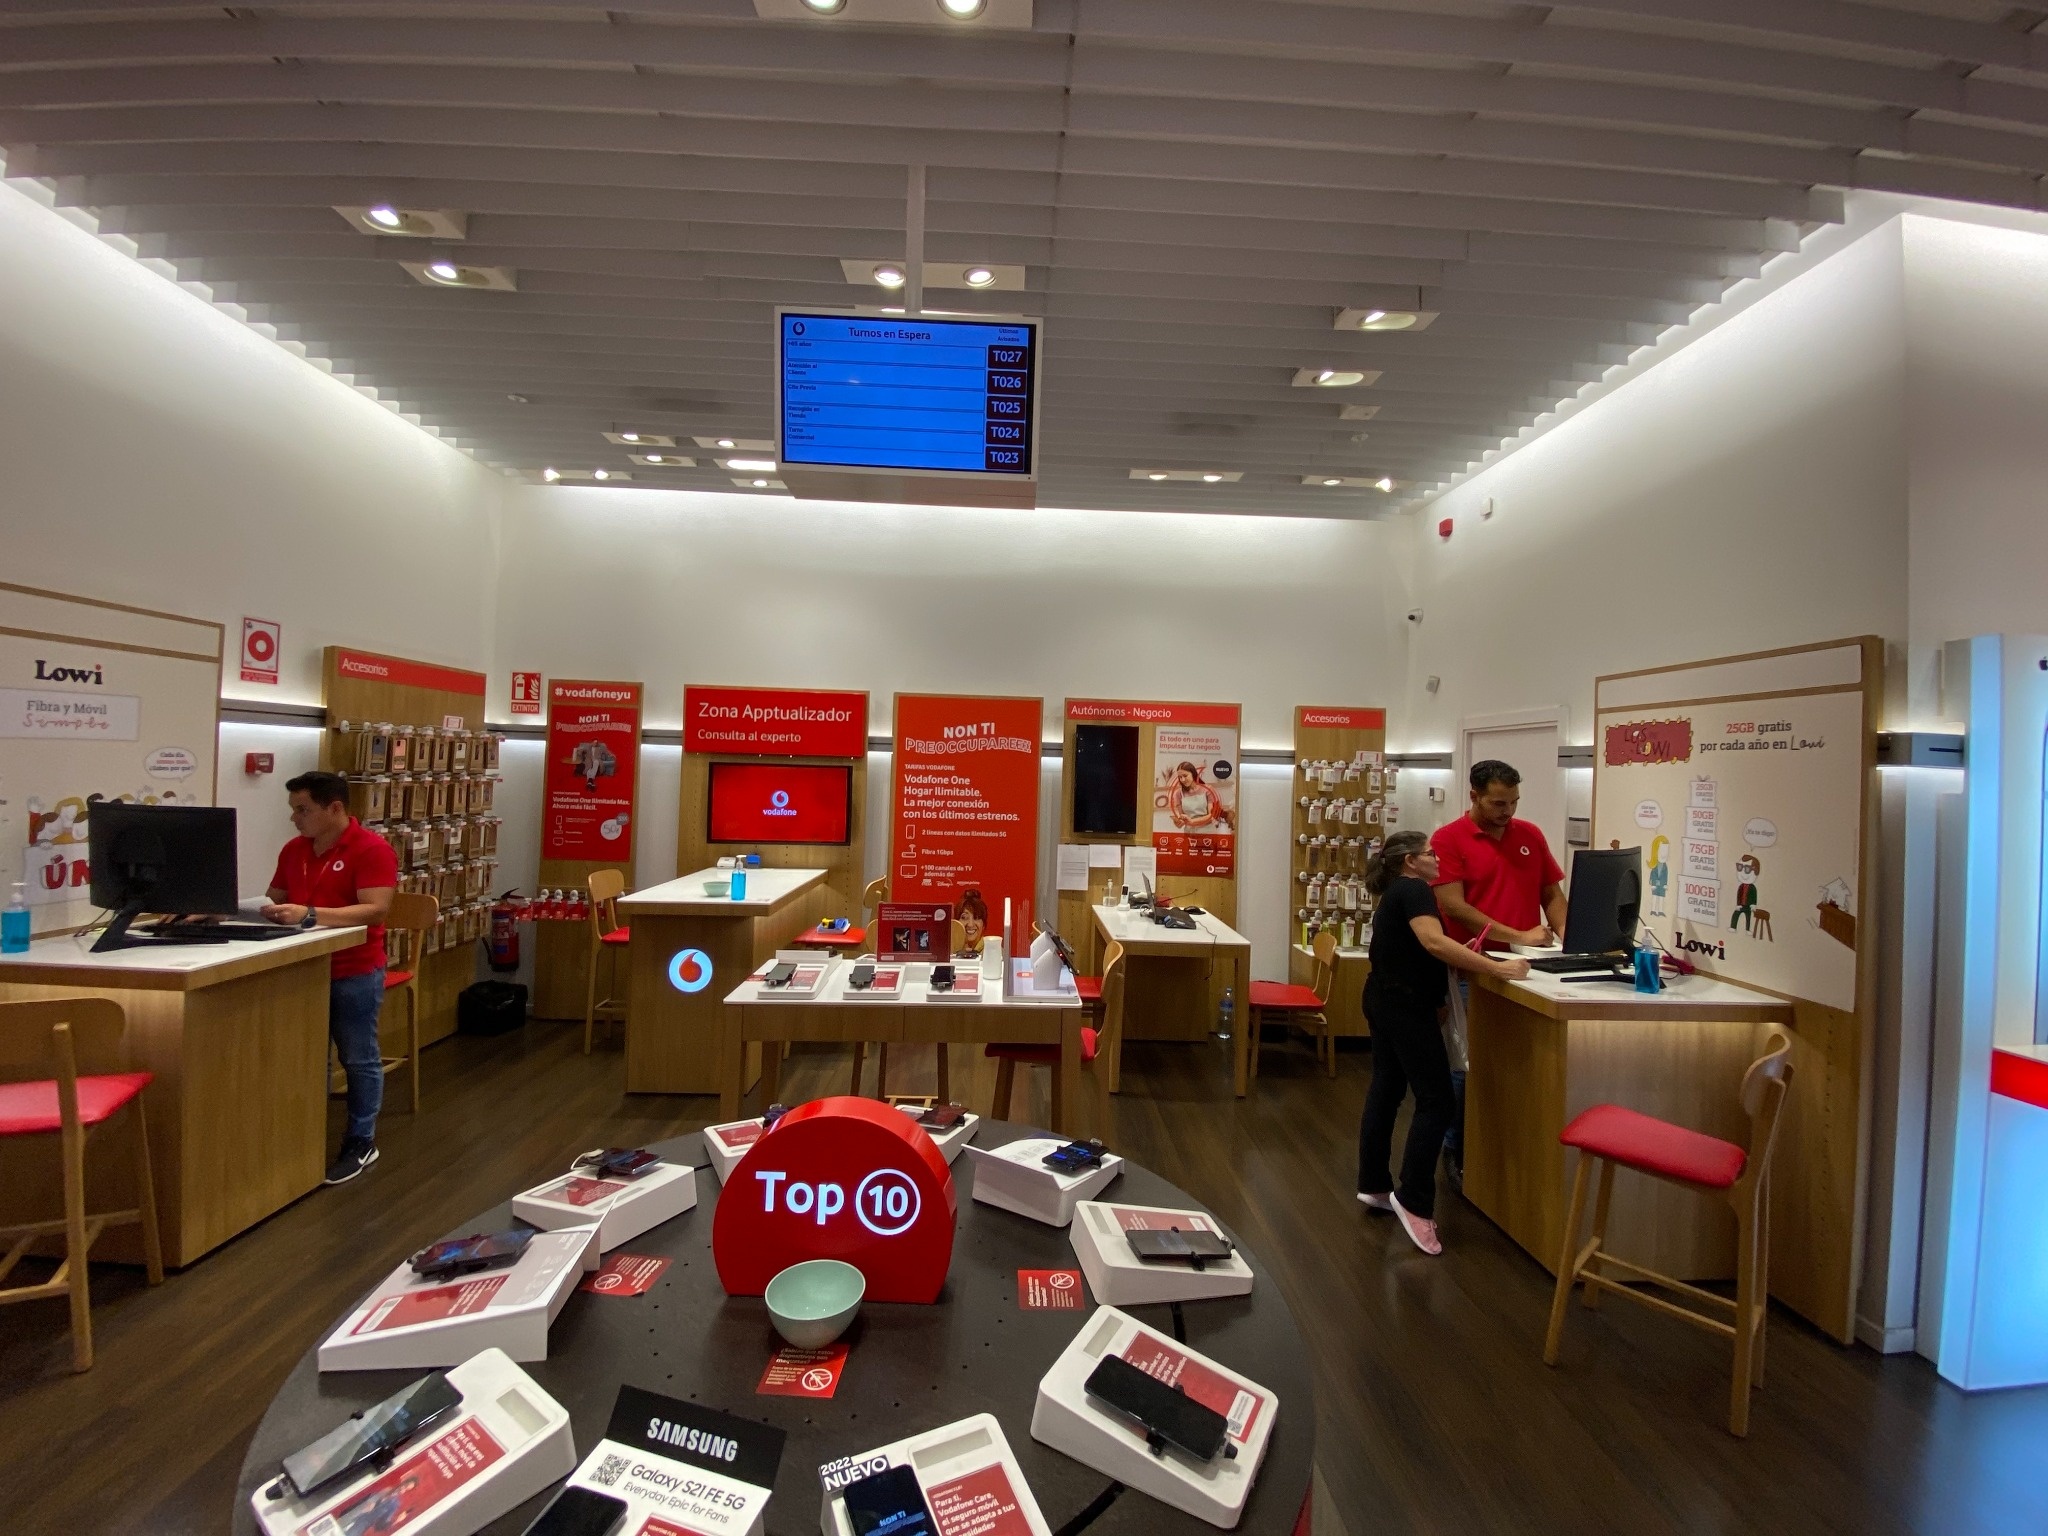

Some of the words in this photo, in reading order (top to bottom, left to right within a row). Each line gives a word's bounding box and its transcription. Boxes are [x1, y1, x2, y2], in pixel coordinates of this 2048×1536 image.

[848, 327, 882, 338] Turnos
[883, 331, 896, 339] en
[898, 330, 931, 341] Espera
[993, 350, 1022, 363] T027
[992, 375, 1021, 388] T026
[991, 400, 1021, 413] T025
[990, 426, 1020, 439] T024
[989, 451, 1019, 464] T023
[34, 659, 103, 685] Lowi
[342, 657, 389, 676] Accesorios
[555, 687, 631, 701] #vodafoneyu
[27, 700, 60, 712] Fibra
[63, 704, 71, 715] y
[73, 703, 107, 715] Móvil
[512, 704, 539, 713] EXTINTOR
[699, 702, 738, 718] Zona
[742, 704, 852, 722] Apptualizador
[1071, 705, 1126, 717] Autónomos
[1133, 707, 1172, 719] Negocio
[579, 714, 599, 723] NON
[1304, 713, 1350, 724] Accesorios
[944, 724, 977, 738] NON
[981, 722, 995, 735] TI
[1726, 722, 1754, 734] 25GB
[1757, 720, 1792, 735] gratis
[698, 729, 746, 741] Consulta
[748, 731, 758, 741] al
[760, 732, 801, 744] experto
[1700, 743, 1718, 753] por
[1720, 740, 1745, 750] cada
[1748, 739, 1769, 750] año
[1772, 741, 1788, 750] en
[904, 774, 949, 784] Vodafone
[951, 775, 971, 785] One
[904, 786, 933, 797] Hogar
[934, 787, 982, 797] Ilimitable.
[1695, 783, 1713, 791] 25GB
[903, 798, 915, 806] La
[917, 798, 945, 809] mejor
[947, 799, 989, 809] conexión
[762, 808, 797, 816] vodafone
[903, 810, 920, 818] con
[922, 809, 937, 819] los
[939, 810, 976, 820] últimos
[977, 812, 1020, 821] estrenos.
[1692, 810, 1714, 819] 50GB
[1690, 843, 1715, 855] 75GB
[1690, 856, 1715, 865] GRATIS
[1685, 883, 1716, 898] 100GB
[1688, 897, 1715, 908] GRATIS
[1675, 931, 1725, 960] Lowi
[755, 1171, 845, 1225] Top
[868, 1185, 908, 1218] 10
[647, 1417, 738, 1462] SAMSUNG
[821, 1457, 851, 1476] 2022
[823, 1457, 887, 1491] NUEVO
[631, 1464, 684, 1492] Galaxy
[681, 1480, 707, 1498] S21
[704, 1487, 725, 1504] FE
[723, 1493, 746, 1510] 5G
[623, 1481, 669, 1505] Everyday
[668, 1496, 690, 1510] Epic
[689, 1502, 705, 1515] for
[705, 1508, 729, 1524] Fans
[935, 1497, 953, 1509] Para
[937, 1500, 974, 1517] Vodafone
[974, 1491, 995, 1504] Care,
[879, 1513, 899, 1527] NON
[897, 1510, 907, 1522] TI
[941, 1518, 951, 1526] el
[950, 1508, 977, 1523] seguro
[978, 1498, 999, 1513] móvil
[945, 1525, 960, 1536] que
[960, 1521, 971, 1530] se
[971, 1510, 997, 1526] adapta
[1003, 1502, 1016, 1513] tus
[959, 1521, 997, 1536] esidades
